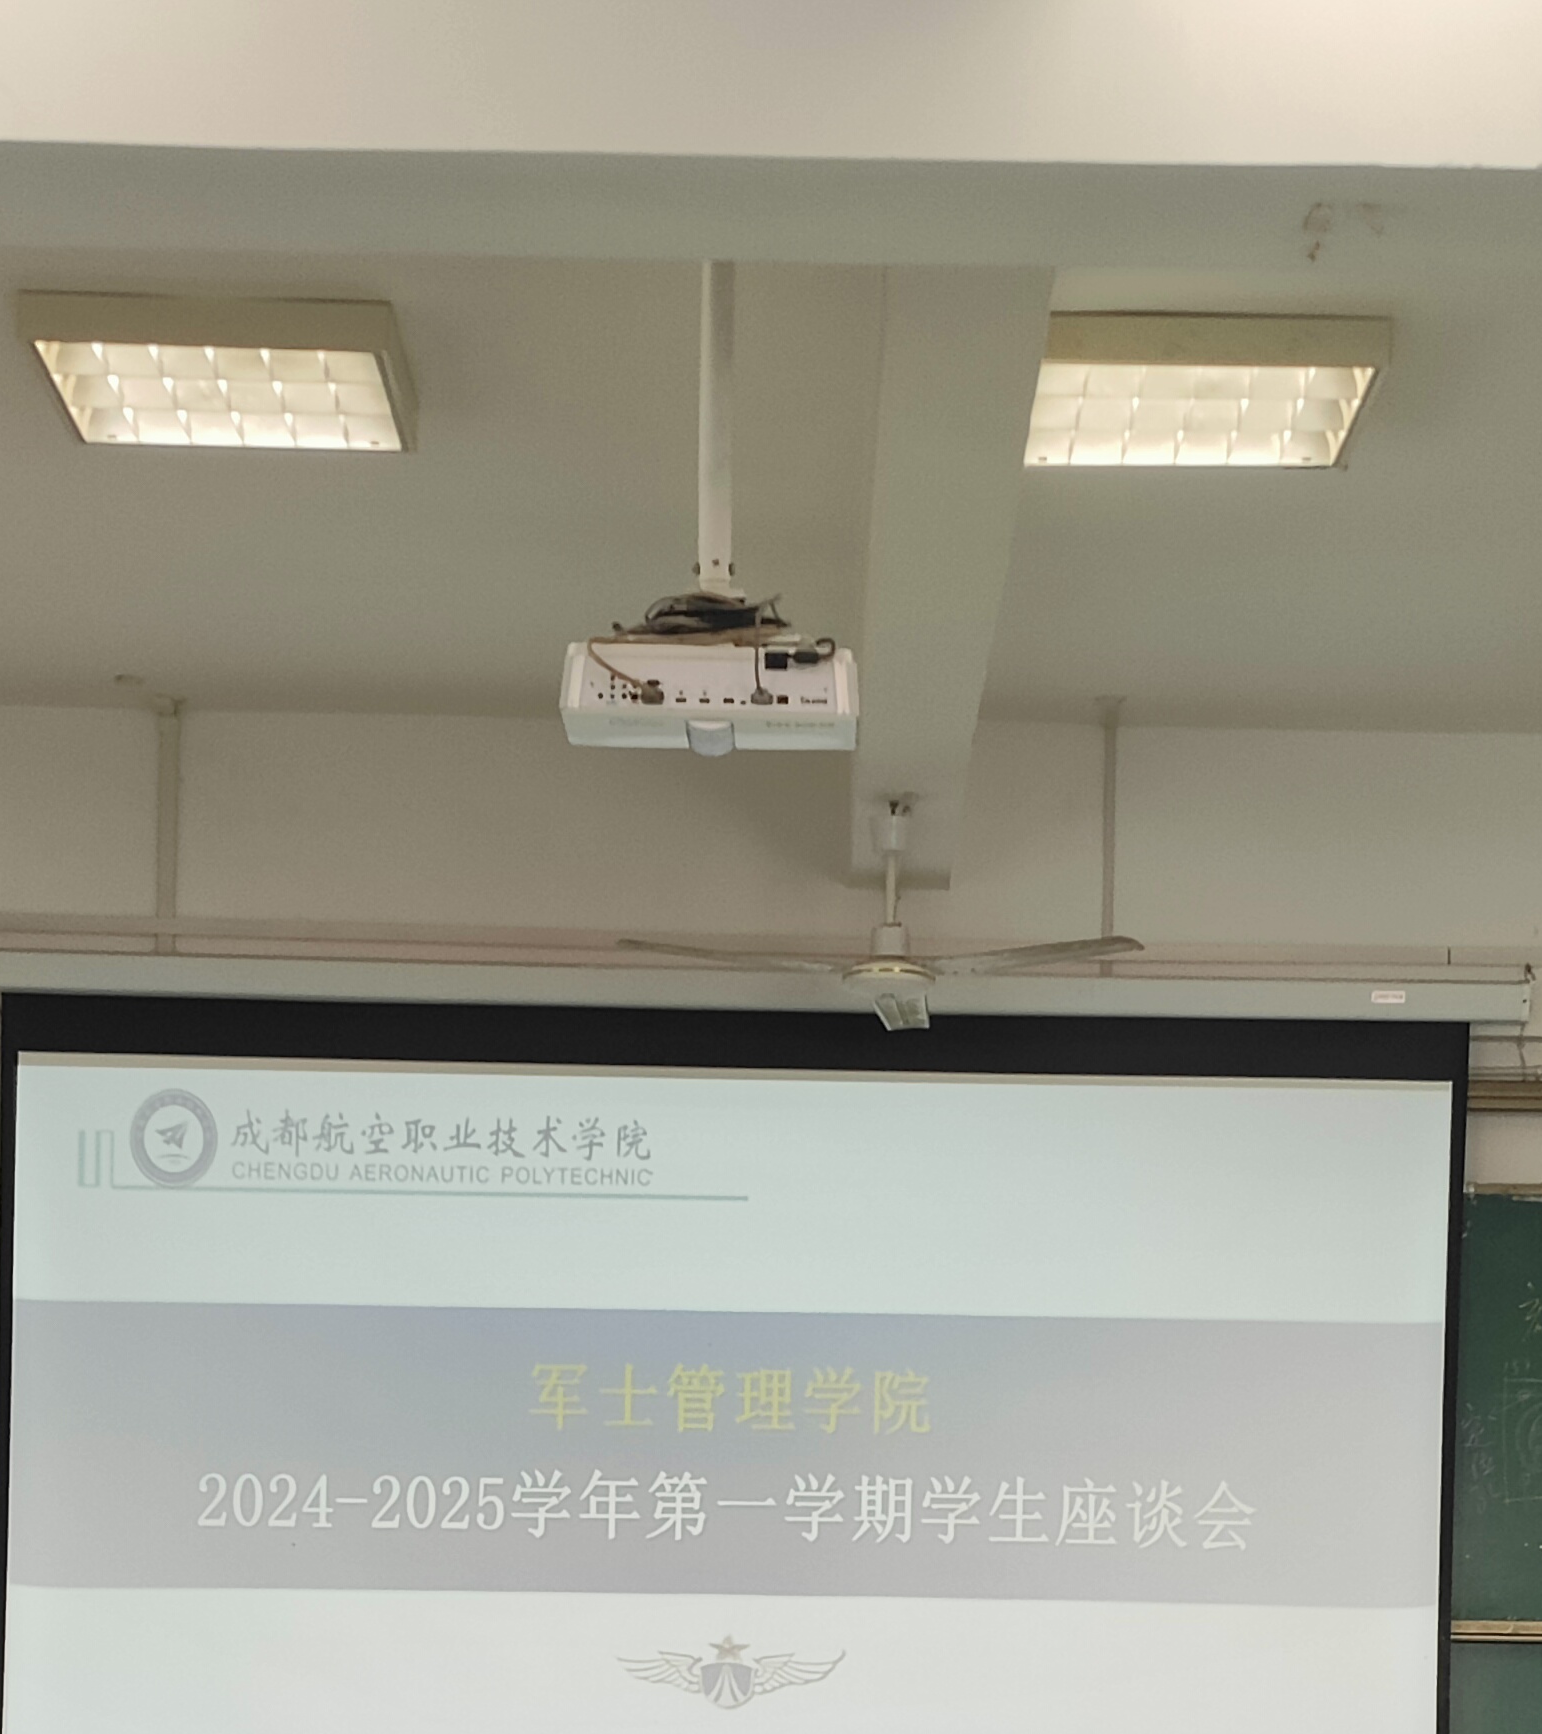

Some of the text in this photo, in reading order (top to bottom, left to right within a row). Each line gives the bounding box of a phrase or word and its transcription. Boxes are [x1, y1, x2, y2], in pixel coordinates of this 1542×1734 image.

[230, 1107, 652, 1162] 成都航空职业技术学院
[231, 1160, 653, 1187] CHENGDU AERONAUTIC POLYTECHNIC
[528, 1363, 935, 1435] 军士管理学院
[195, 1469, 1258, 1553] 2024-2025学年第一学期学生座谈会
